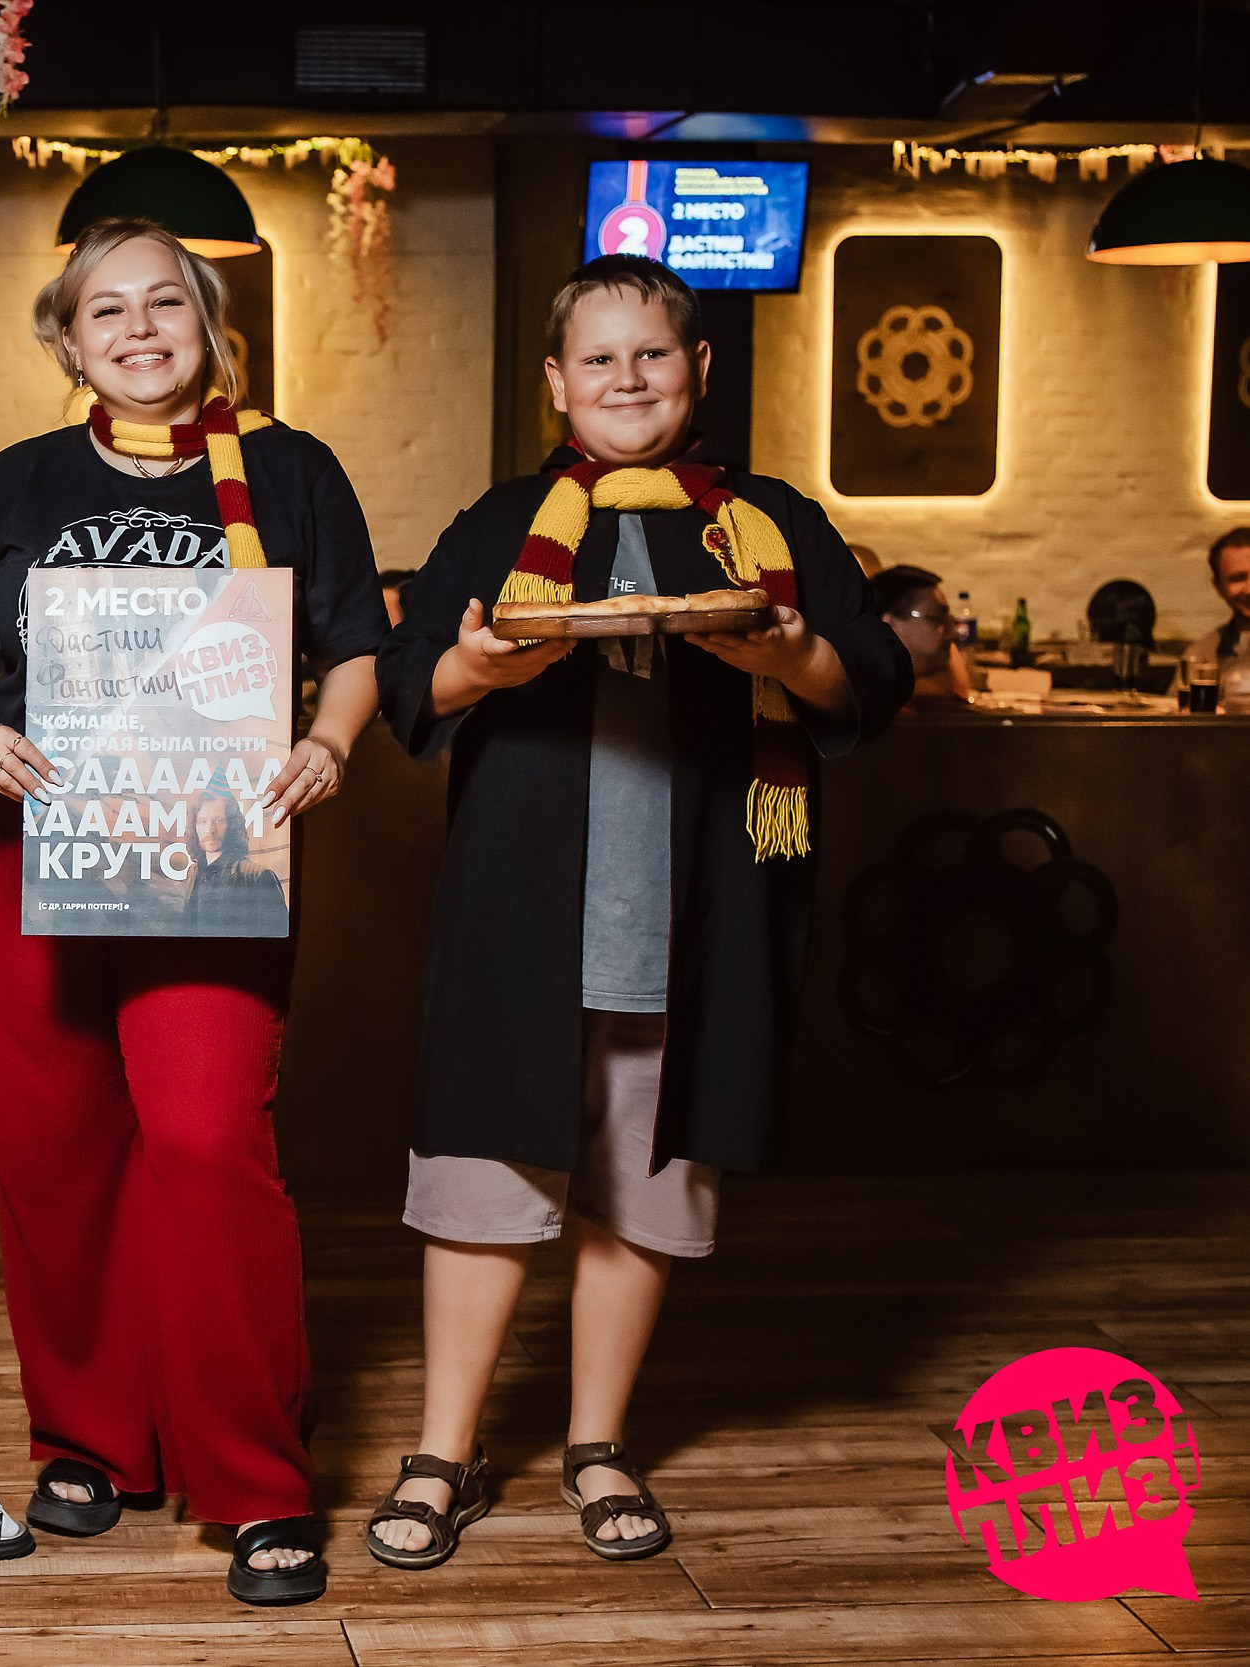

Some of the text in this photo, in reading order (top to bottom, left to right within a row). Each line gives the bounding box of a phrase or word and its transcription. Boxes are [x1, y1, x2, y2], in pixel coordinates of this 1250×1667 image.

[616, 216, 649, 255] 2
[44, 526, 231, 568] AVADA
[44, 587, 208, 616] 2 МЕСТО
[42, 714, 145, 732] КОМАНДЕ,
[42, 736, 267, 752] КОТОРАЯ БЫЛА ПОЧТИ
[39, 843, 196, 880] КРУТО
[62, 902, 87, 911] ГАРРИ
